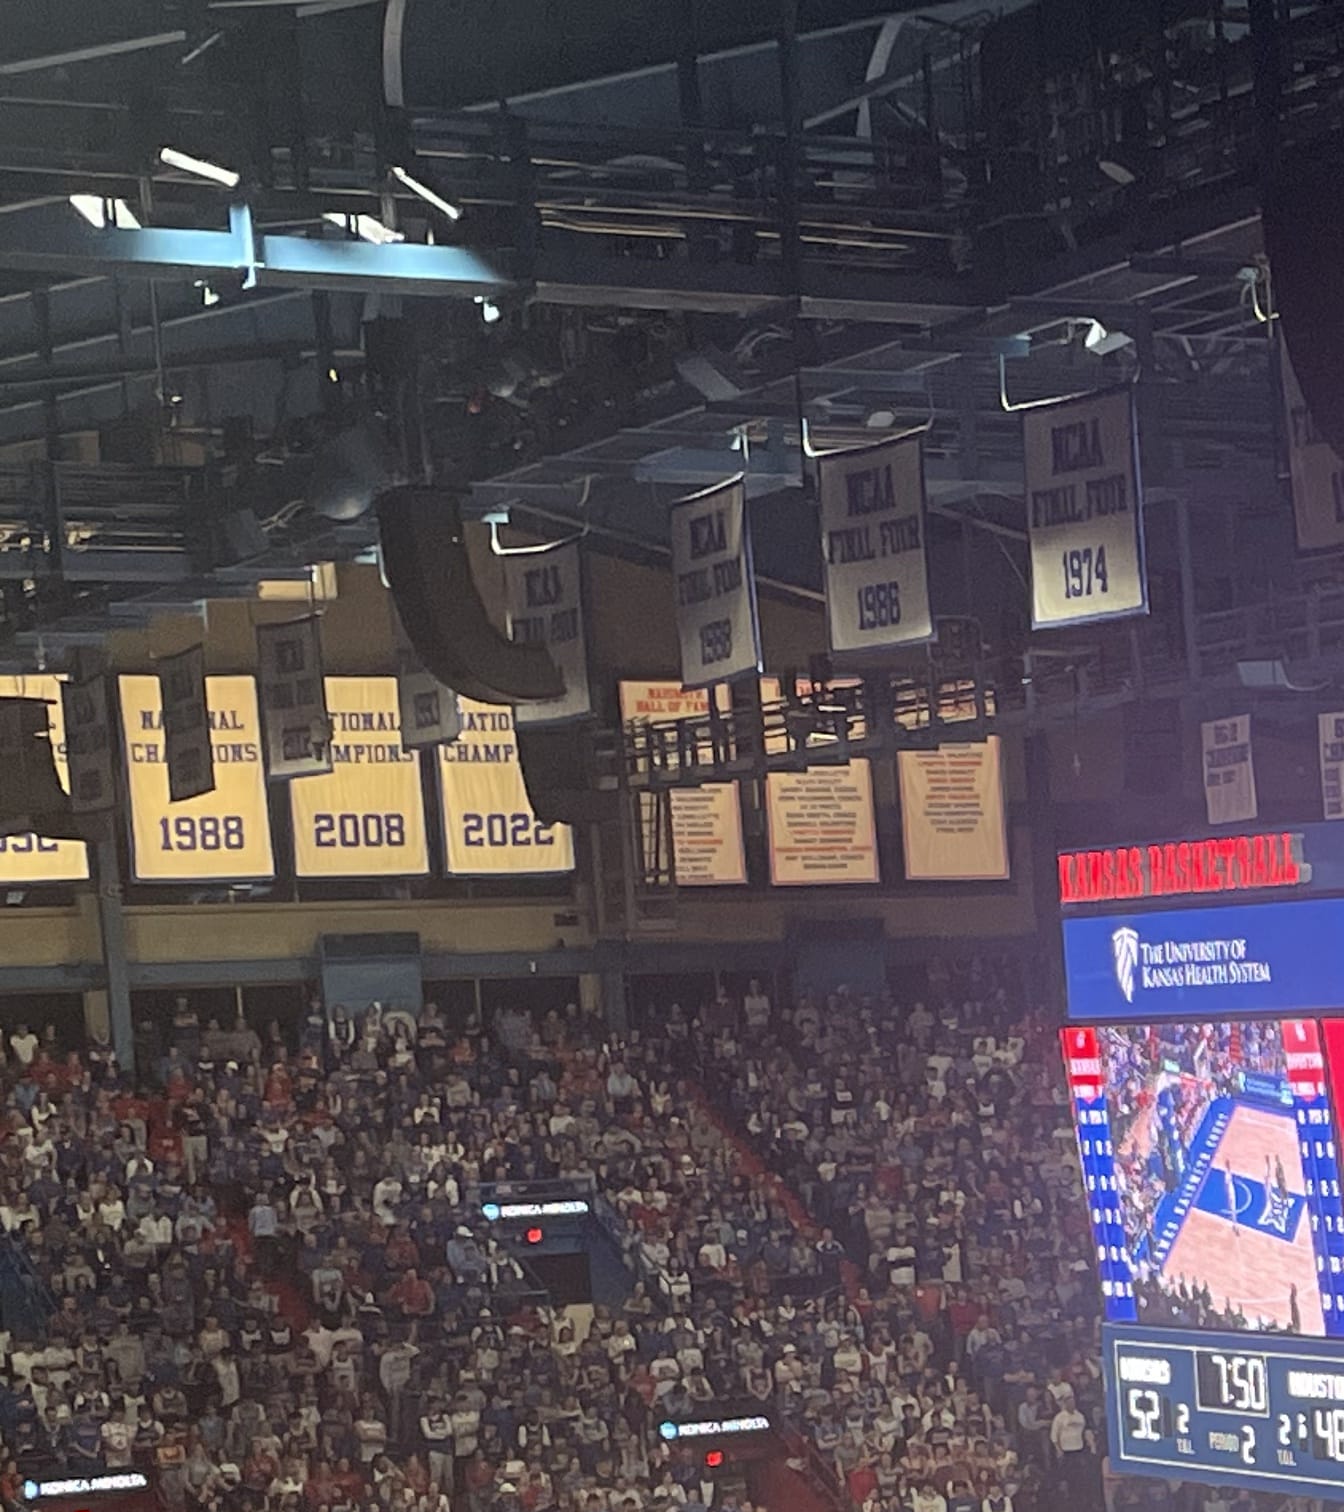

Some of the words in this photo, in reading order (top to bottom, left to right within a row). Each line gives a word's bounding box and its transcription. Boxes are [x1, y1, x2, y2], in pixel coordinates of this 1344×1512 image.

[1063, 544, 1108, 598] 1974
[636, 702, 663, 713] HALL
[160, 816, 245, 851] 1988
[314, 814, 405, 847] 2008
[1058, 847, 1145, 904] KANSAS
[1148, 832, 1304, 897] BASKETBALL
[1141, 941, 1164, 965] THE
[1165, 939, 1230, 965] UNIVERSITY
[1230, 939, 1247, 960] OF
[1142, 964, 1184, 989] KANSAS
[1185, 962, 1227, 987] HEALTH
[1229, 961, 1271, 986] SYSTEM
[501, 1203, 541, 1218] KONICA
[542, 1201, 588, 1215] MINOLTA
[1212, 1355, 1267, 1411] 7:50
[679, 1422, 721, 1437] KONICA
[722, 1416, 769, 1433] MINOLTA
[1128, 1388, 1161, 1441] 52
[1176, 1403, 1191, 1433] 2
[1279, 1413, 1292, 1446] 2
[1241, 1425, 1256, 1465] 2
[40, 1480, 90, 1496] KONICA
[90, 1473, 147, 1490] MINOLTA
